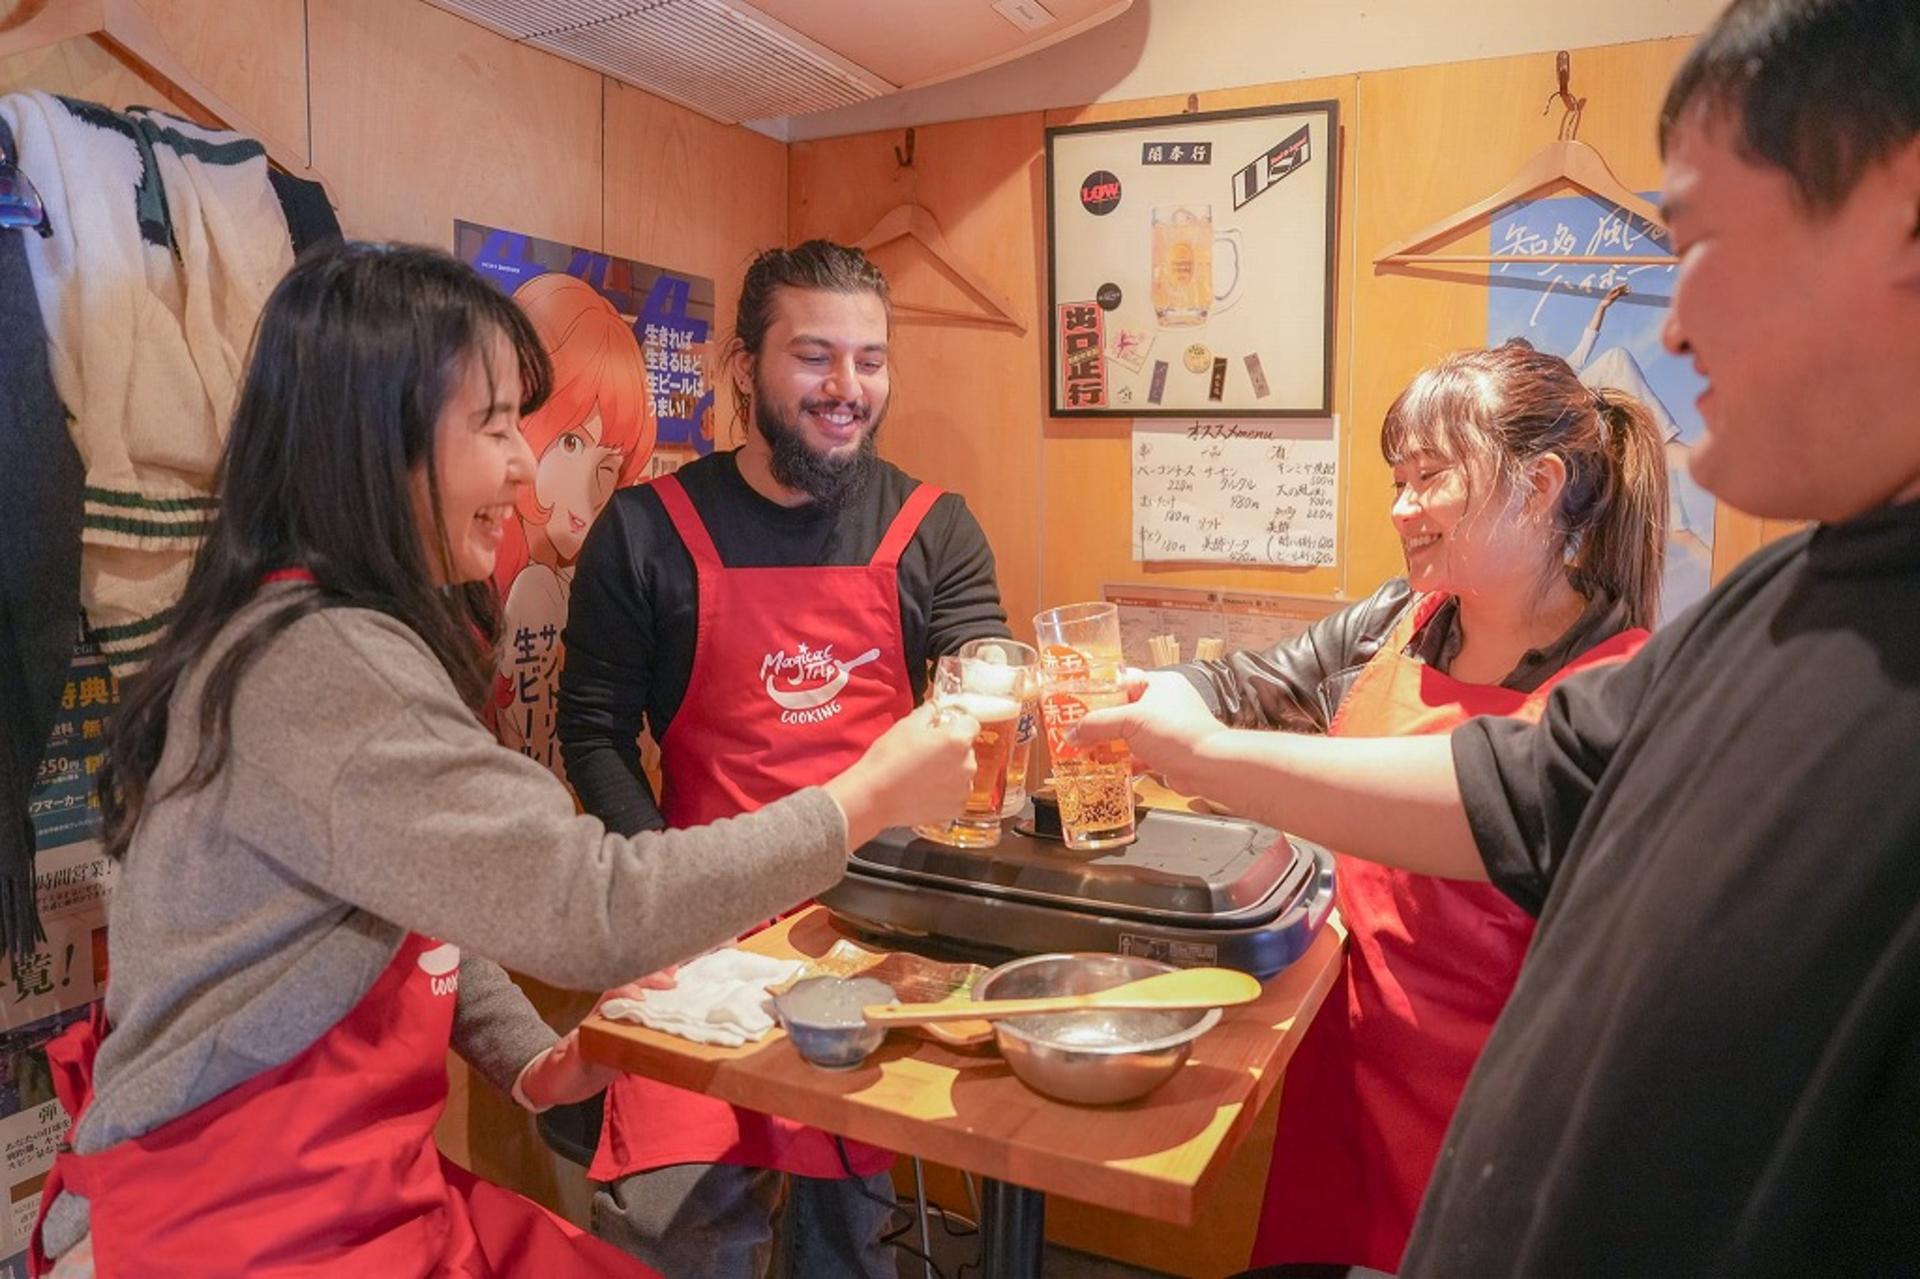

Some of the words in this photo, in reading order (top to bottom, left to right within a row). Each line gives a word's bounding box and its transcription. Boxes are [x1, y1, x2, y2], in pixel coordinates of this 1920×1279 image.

[645, 323, 695, 350] 生きれば
[646, 372, 706, 398] 生ビールは
[781, 701, 842, 725] COOKING
